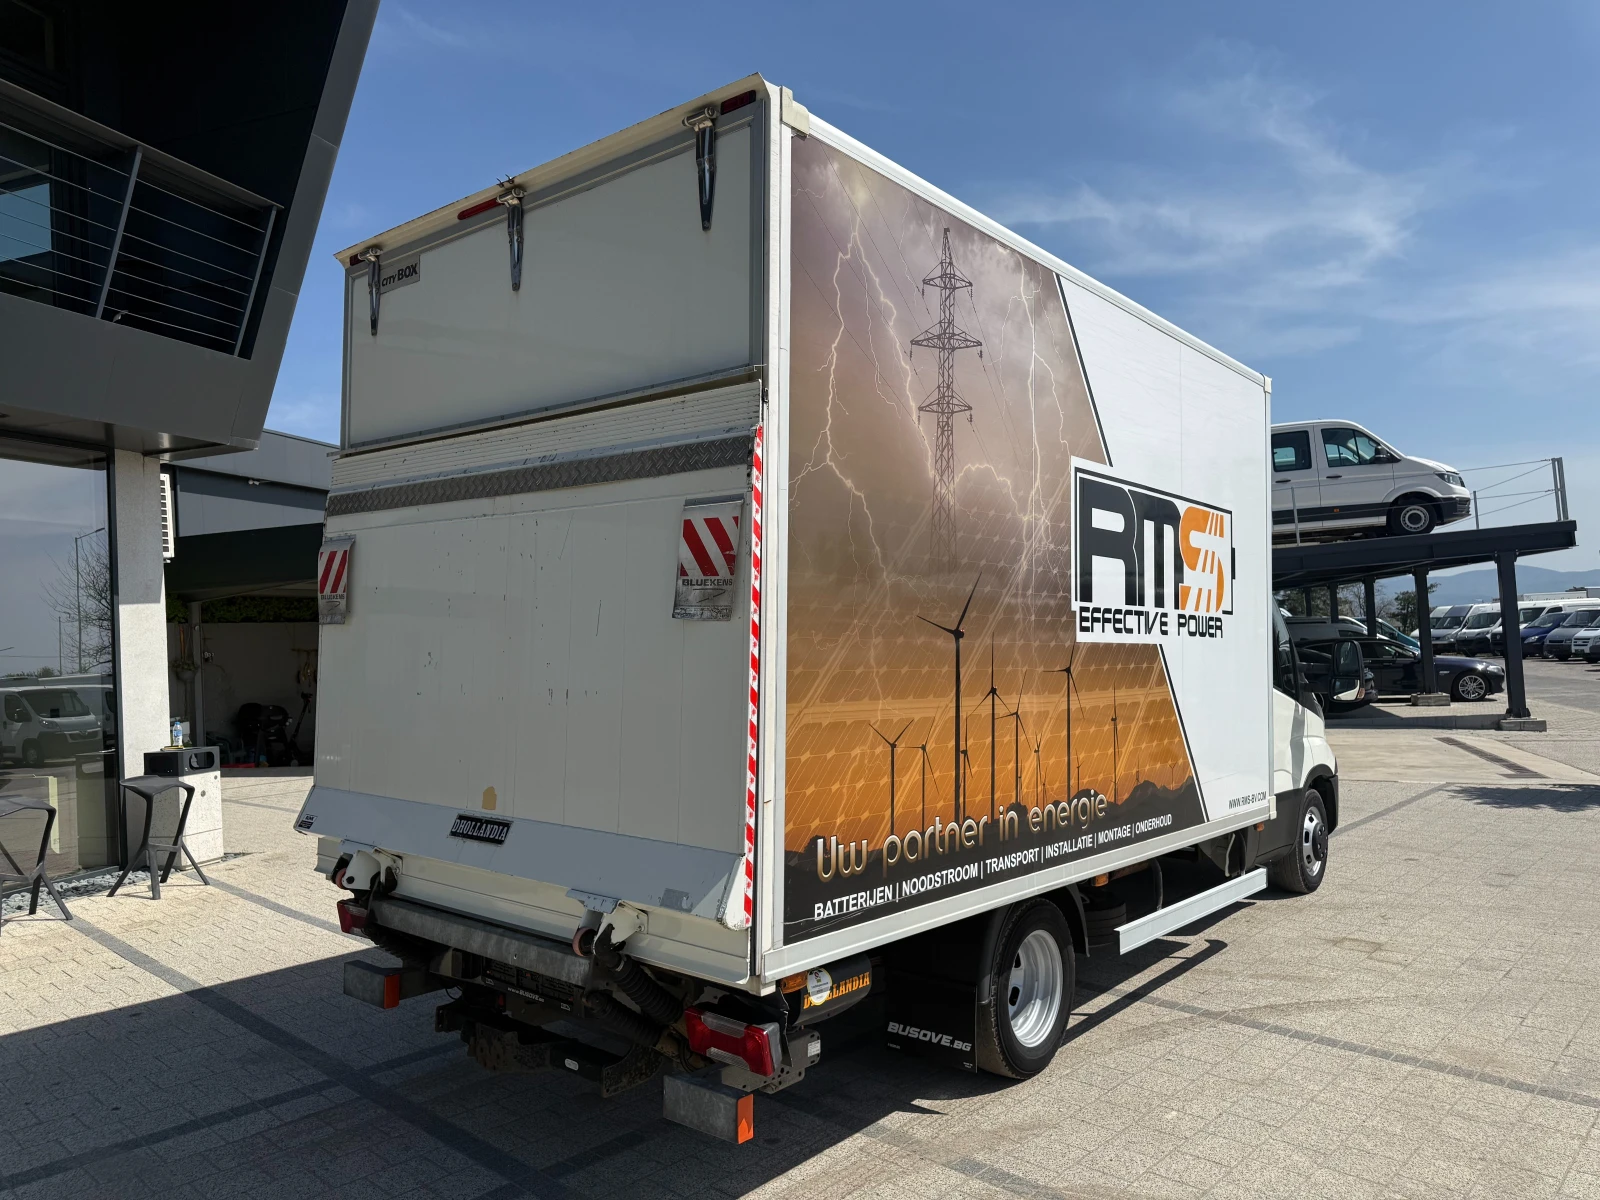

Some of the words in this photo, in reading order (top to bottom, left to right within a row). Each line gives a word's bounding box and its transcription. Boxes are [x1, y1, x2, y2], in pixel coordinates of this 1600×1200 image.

[381, 273, 397, 287] CITY
[397, 262, 419, 281] BOX
[1079, 476, 1225, 613] RMS
[682, 578, 733, 588] BLUEKENS
[1079, 606, 1169, 636] EFFECTIVE
[1177, 613, 1223, 639] POWER
[451, 819, 508, 841] DHOLLANDIA
[816, 835, 868, 883] Uw
[882, 815, 988, 879] partner
[998, 805, 1019, 842] in
[1028, 789, 1108, 834] energie
[814, 884, 893, 922] BATTERIJEN
[902, 862, 978, 897] NOODSTROOM
[985, 847, 1040, 874] TRANSPORT
[1045, 834, 1093, 859] INSTALLATIE
[1098, 823, 1131, 845] MONTAGE
[1135, 813, 1173, 834] ONDERHOUD
[887, 1021, 972, 1052] BUSOVE.BG
